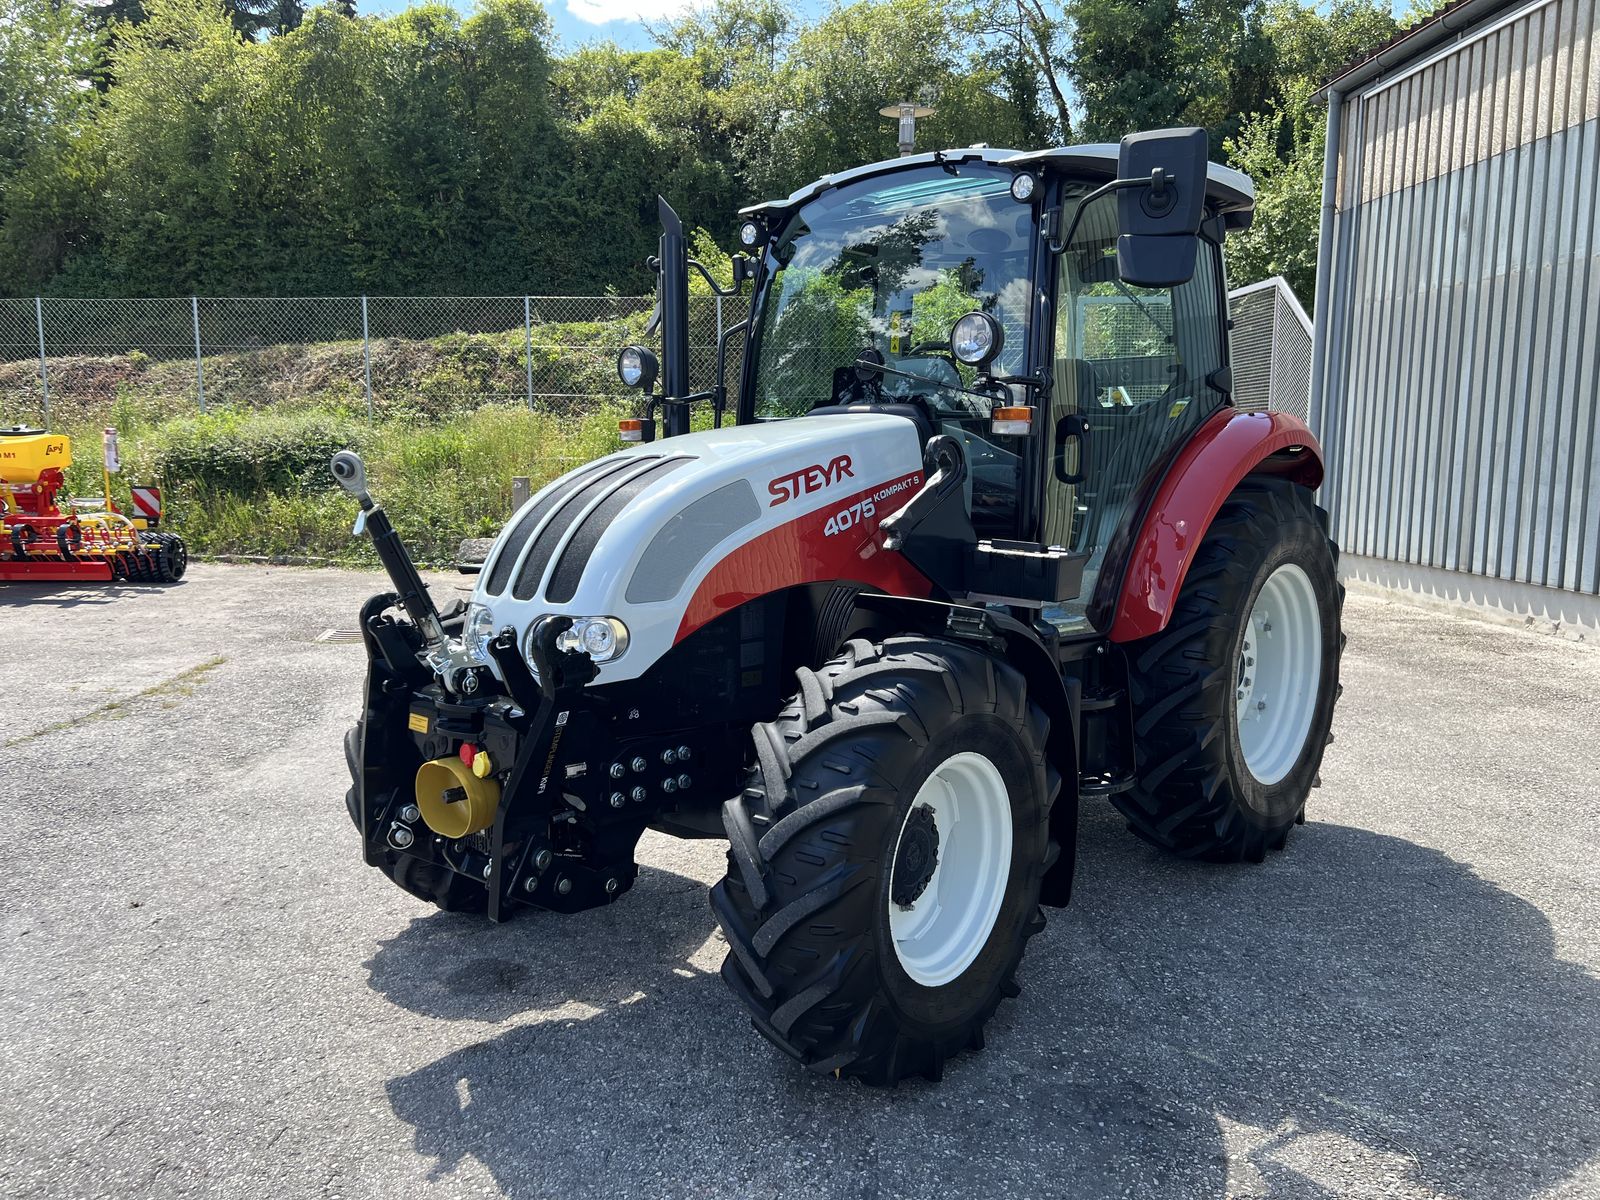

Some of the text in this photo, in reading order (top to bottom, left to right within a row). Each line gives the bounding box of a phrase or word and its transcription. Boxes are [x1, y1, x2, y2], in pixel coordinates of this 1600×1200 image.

[768, 454, 855, 507] STEYR
[823, 475, 920, 537] 4075 KOMPAKT S
